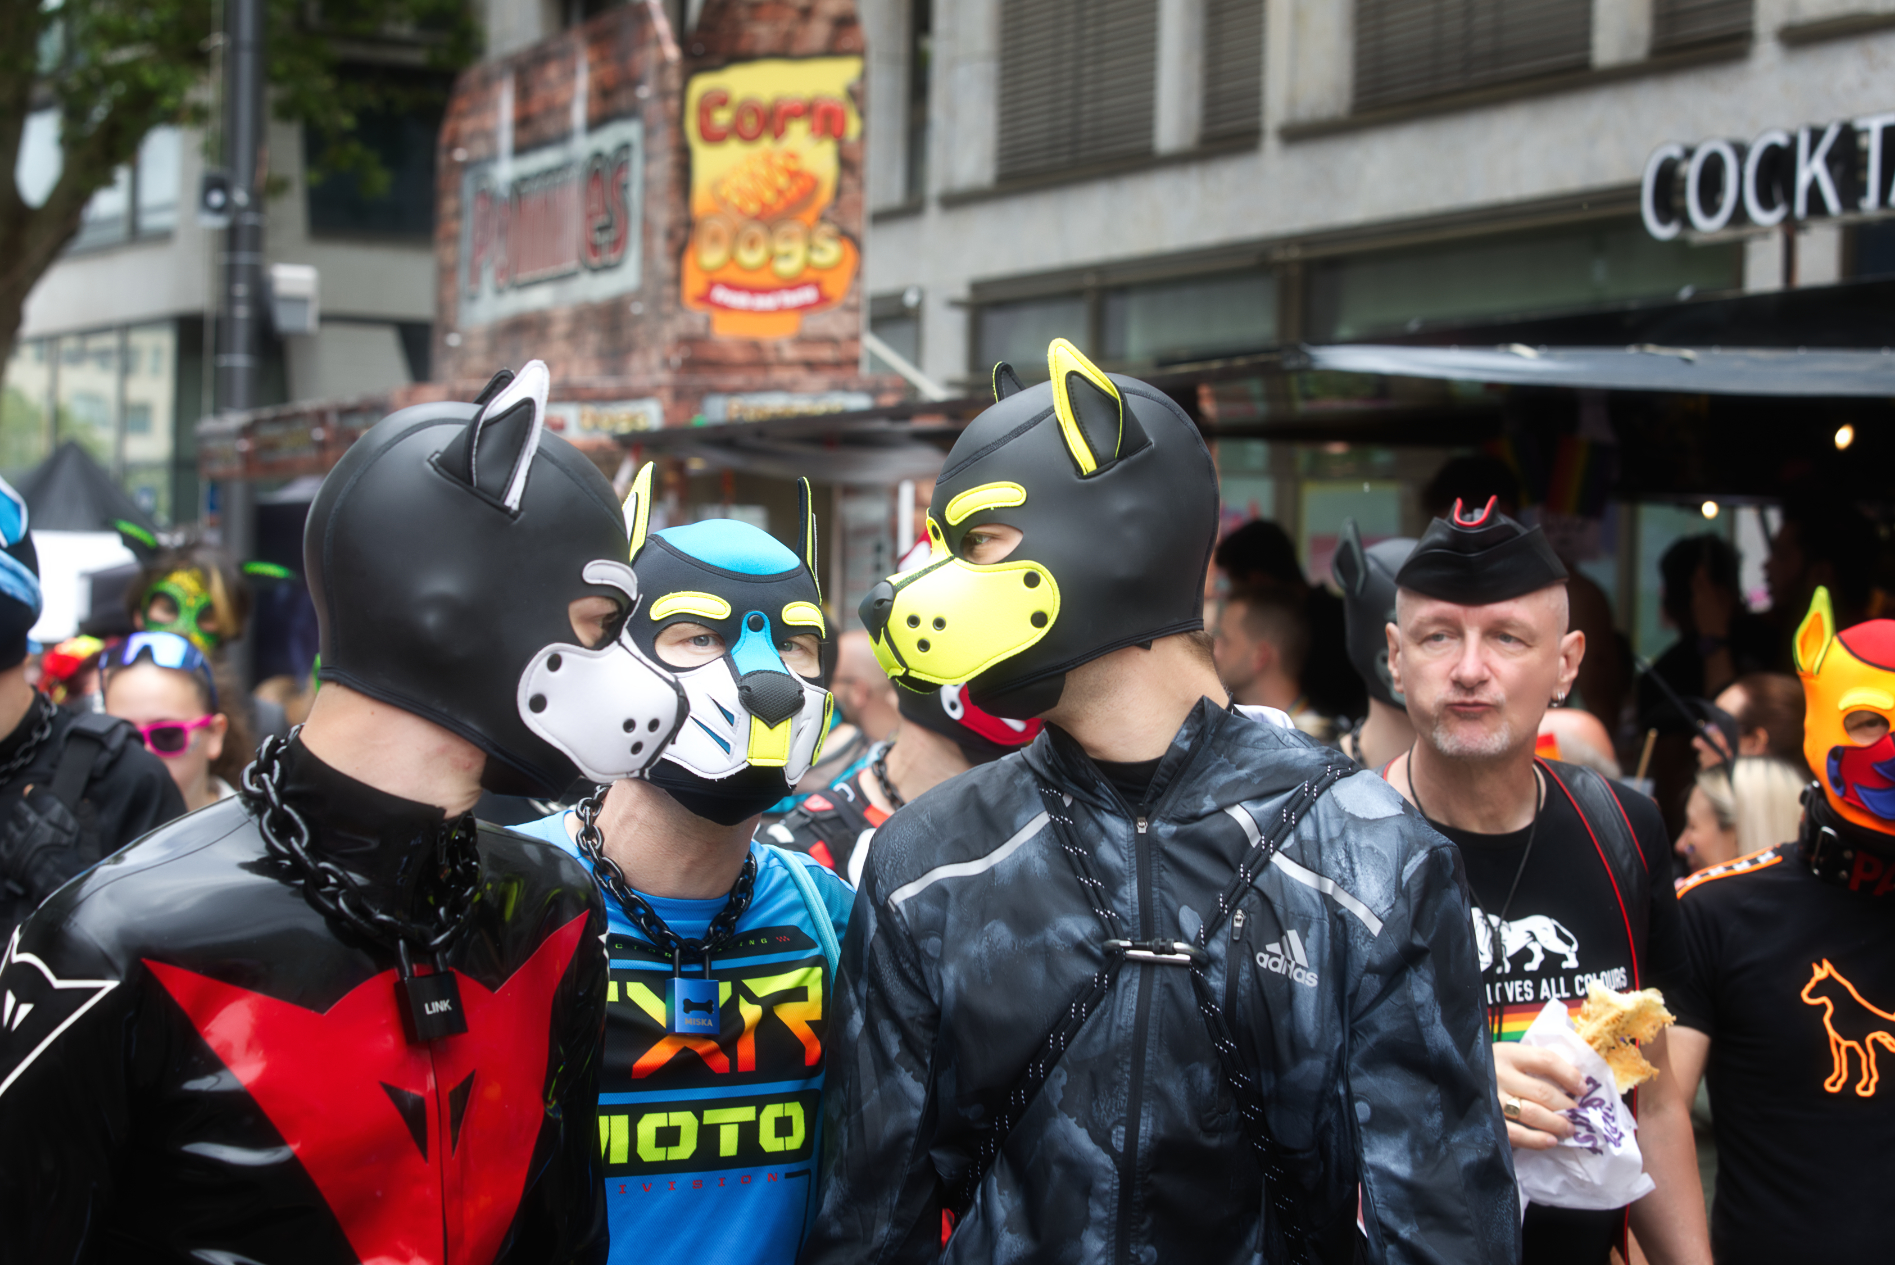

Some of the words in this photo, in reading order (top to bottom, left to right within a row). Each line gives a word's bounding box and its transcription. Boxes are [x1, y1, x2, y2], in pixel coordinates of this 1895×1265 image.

[697, 89, 847, 144] Corn
[1640, 110, 1895, 242] COCKT
[697, 213, 845, 279] Dogs
[424, 999, 452, 1015] LINK
[1539, 976, 1571, 1000] ALL
[606, 966, 823, 1079] XR
[684, 1017, 713, 1027] MISKA
[618, 1172, 778, 1194] IVISION
